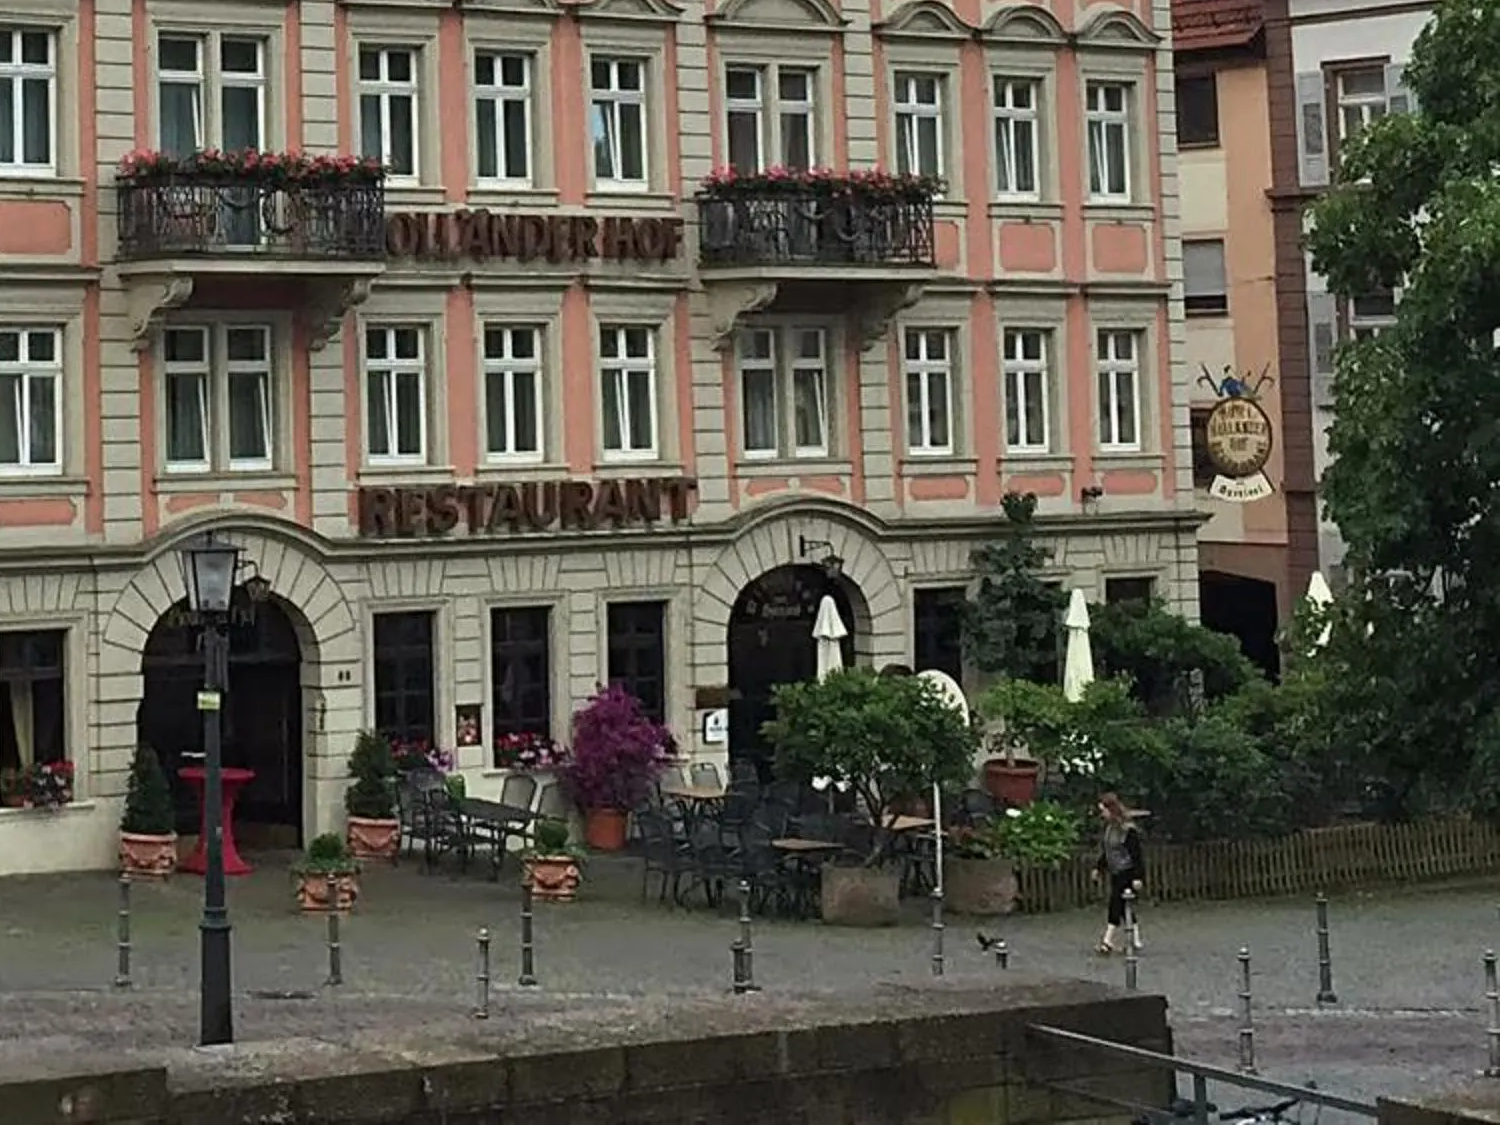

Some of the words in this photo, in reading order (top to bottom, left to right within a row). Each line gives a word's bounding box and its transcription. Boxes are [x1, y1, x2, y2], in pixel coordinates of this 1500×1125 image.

[386, 208, 599, 264] OLLÄNDER
[602, 216, 684, 265] HOF
[358, 478, 697, 537] RESTAURANT
